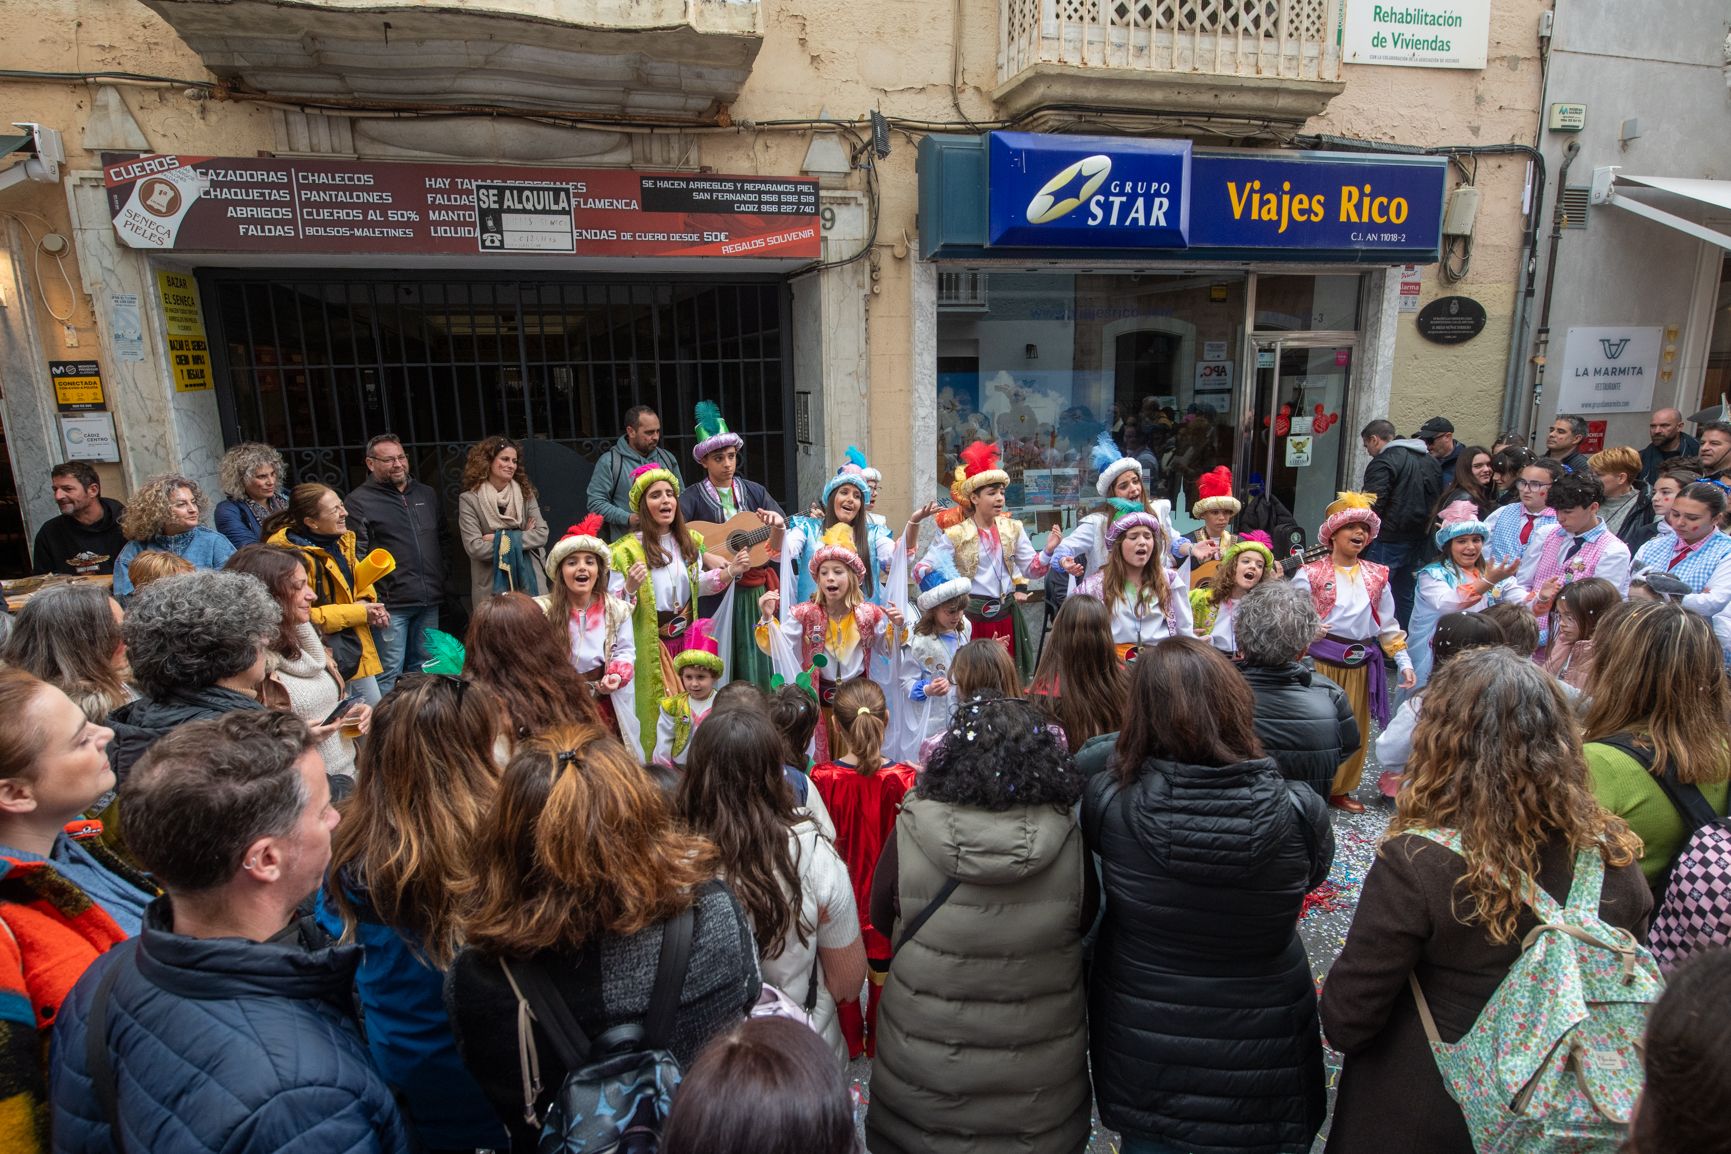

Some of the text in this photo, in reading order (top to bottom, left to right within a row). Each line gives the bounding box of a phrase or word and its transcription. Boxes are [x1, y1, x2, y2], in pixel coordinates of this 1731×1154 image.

[1373, 5, 1462, 27] Rehabilitación
[1372, 32, 1451, 51] de Viviendas
[110, 156, 179, 181] CUEROS
[197, 169, 288, 182] CAZADORAS
[299, 173, 374, 185] CHALECOS
[426, 178, 450, 188] HAY
[689, 182, 734, 190] ARREGLOS
[744, 183, 794, 191] REPARAMOS
[1111, 181, 1170, 194] GRUPO
[200, 188, 290, 200] CHAQUETAS
[301, 191, 392, 203] PANTALONES
[479, 189, 569, 210] SE ALQUILA
[713, 193, 758, 201] FERNANDO
[573, 199, 638, 210] FLAMENCA
[1087, 195, 1169, 226] STAR
[1227, 180, 1408, 233] Viajes Rico
[227, 207, 292, 218] ABRIGOS
[303, 209, 419, 221] CUEROS AL 50%
[125, 209, 170, 238] SENECA
[821, 208, 835, 230] 9
[124, 221, 164, 246] PIELES
[239, 225, 294, 236] FALDAS
[306, 227, 413, 237] BOLSOS-MALETINES
[670, 233, 700, 241] DESDE
[704, 232, 728, 241] 50€
[722, 229, 814, 254] REGALOS SOUVENIR
[1366, 233, 1377, 241] AN
[1380, 233, 1405, 241] 11018-2
[167, 276, 188, 289] BAZAR
[164, 293, 195, 307] EL SENECA
[1576, 367, 1643, 376] LA MARMITA
